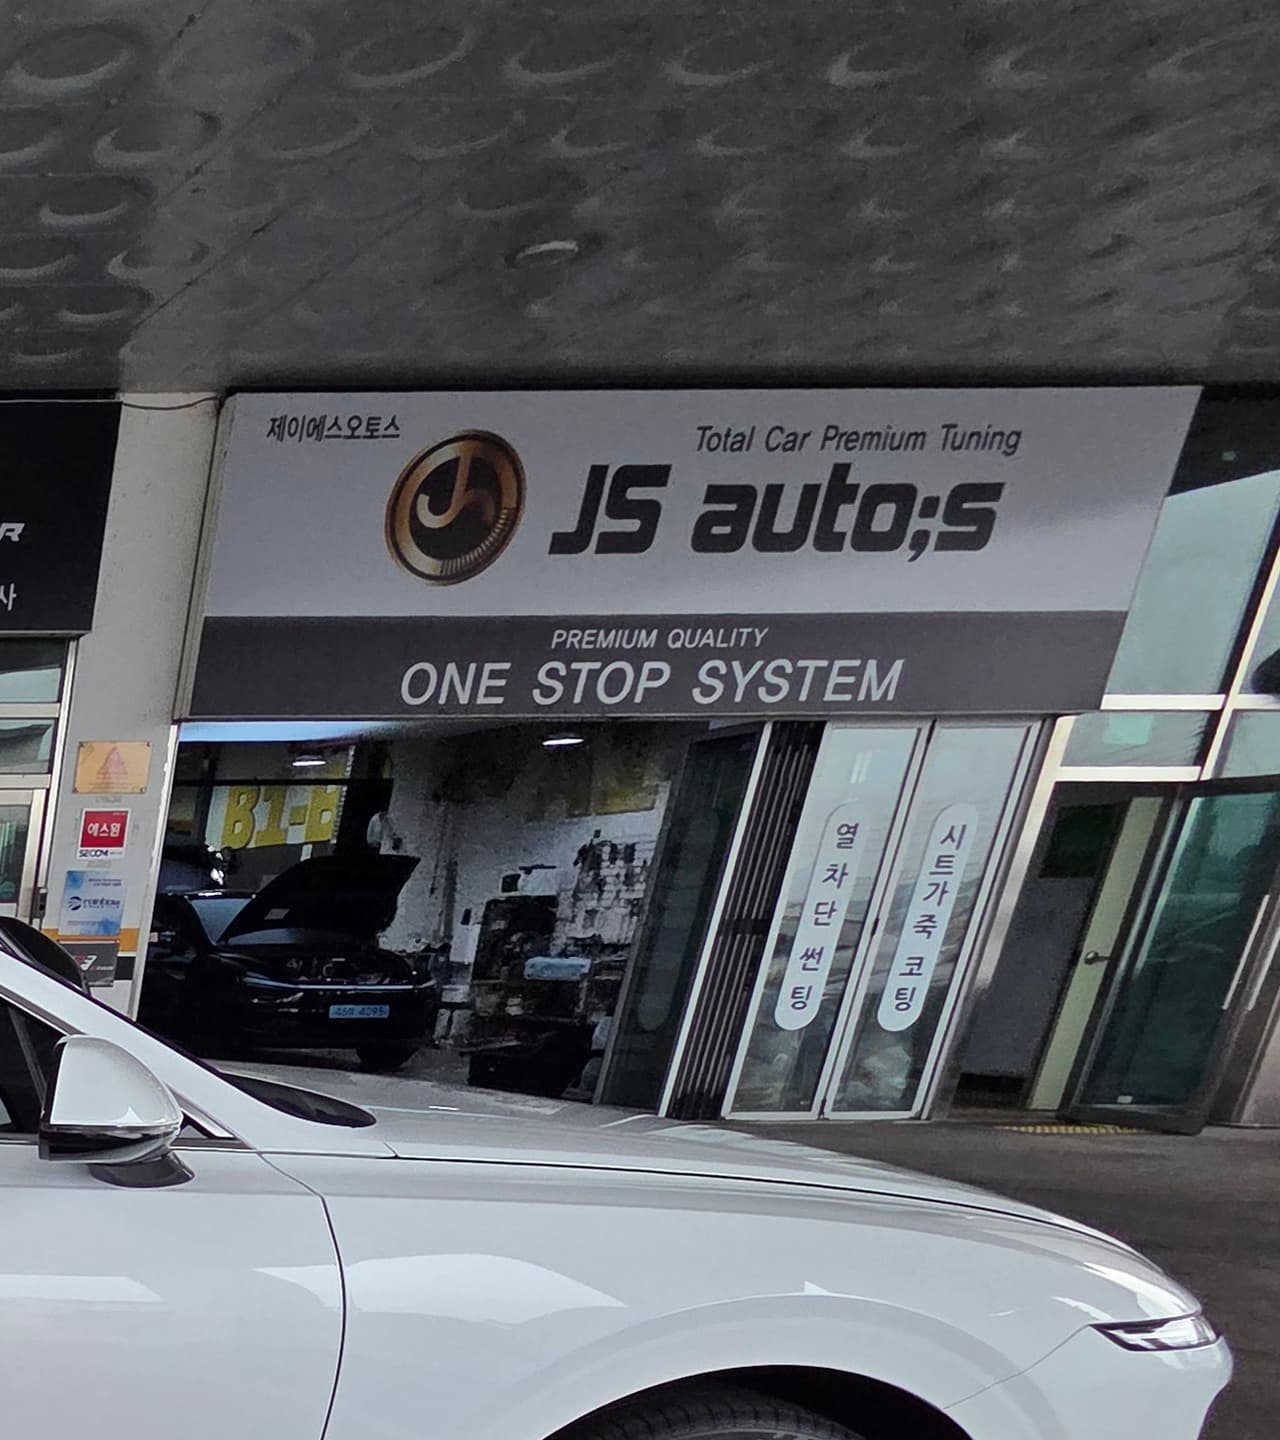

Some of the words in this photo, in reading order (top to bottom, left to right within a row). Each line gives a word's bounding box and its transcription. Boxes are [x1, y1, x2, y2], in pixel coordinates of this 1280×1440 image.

[266, 414, 401, 442] 제이에스오토스
[695, 425, 756, 452] Total
[765, 425, 812, 452] Car
[820, 424, 927, 451] Premium
[940, 423, 1023, 457] Tuning
[548, 464, 672, 555] JS
[691, 462, 1006, 562] auto;s
[551, 629, 658, 649] PREMIUM
[667, 627, 769, 649] QUALITY
[400, 662, 512, 705] ONE
[531, 660, 672, 704] STOP
[692, 659, 905, 704] SYSTEM
